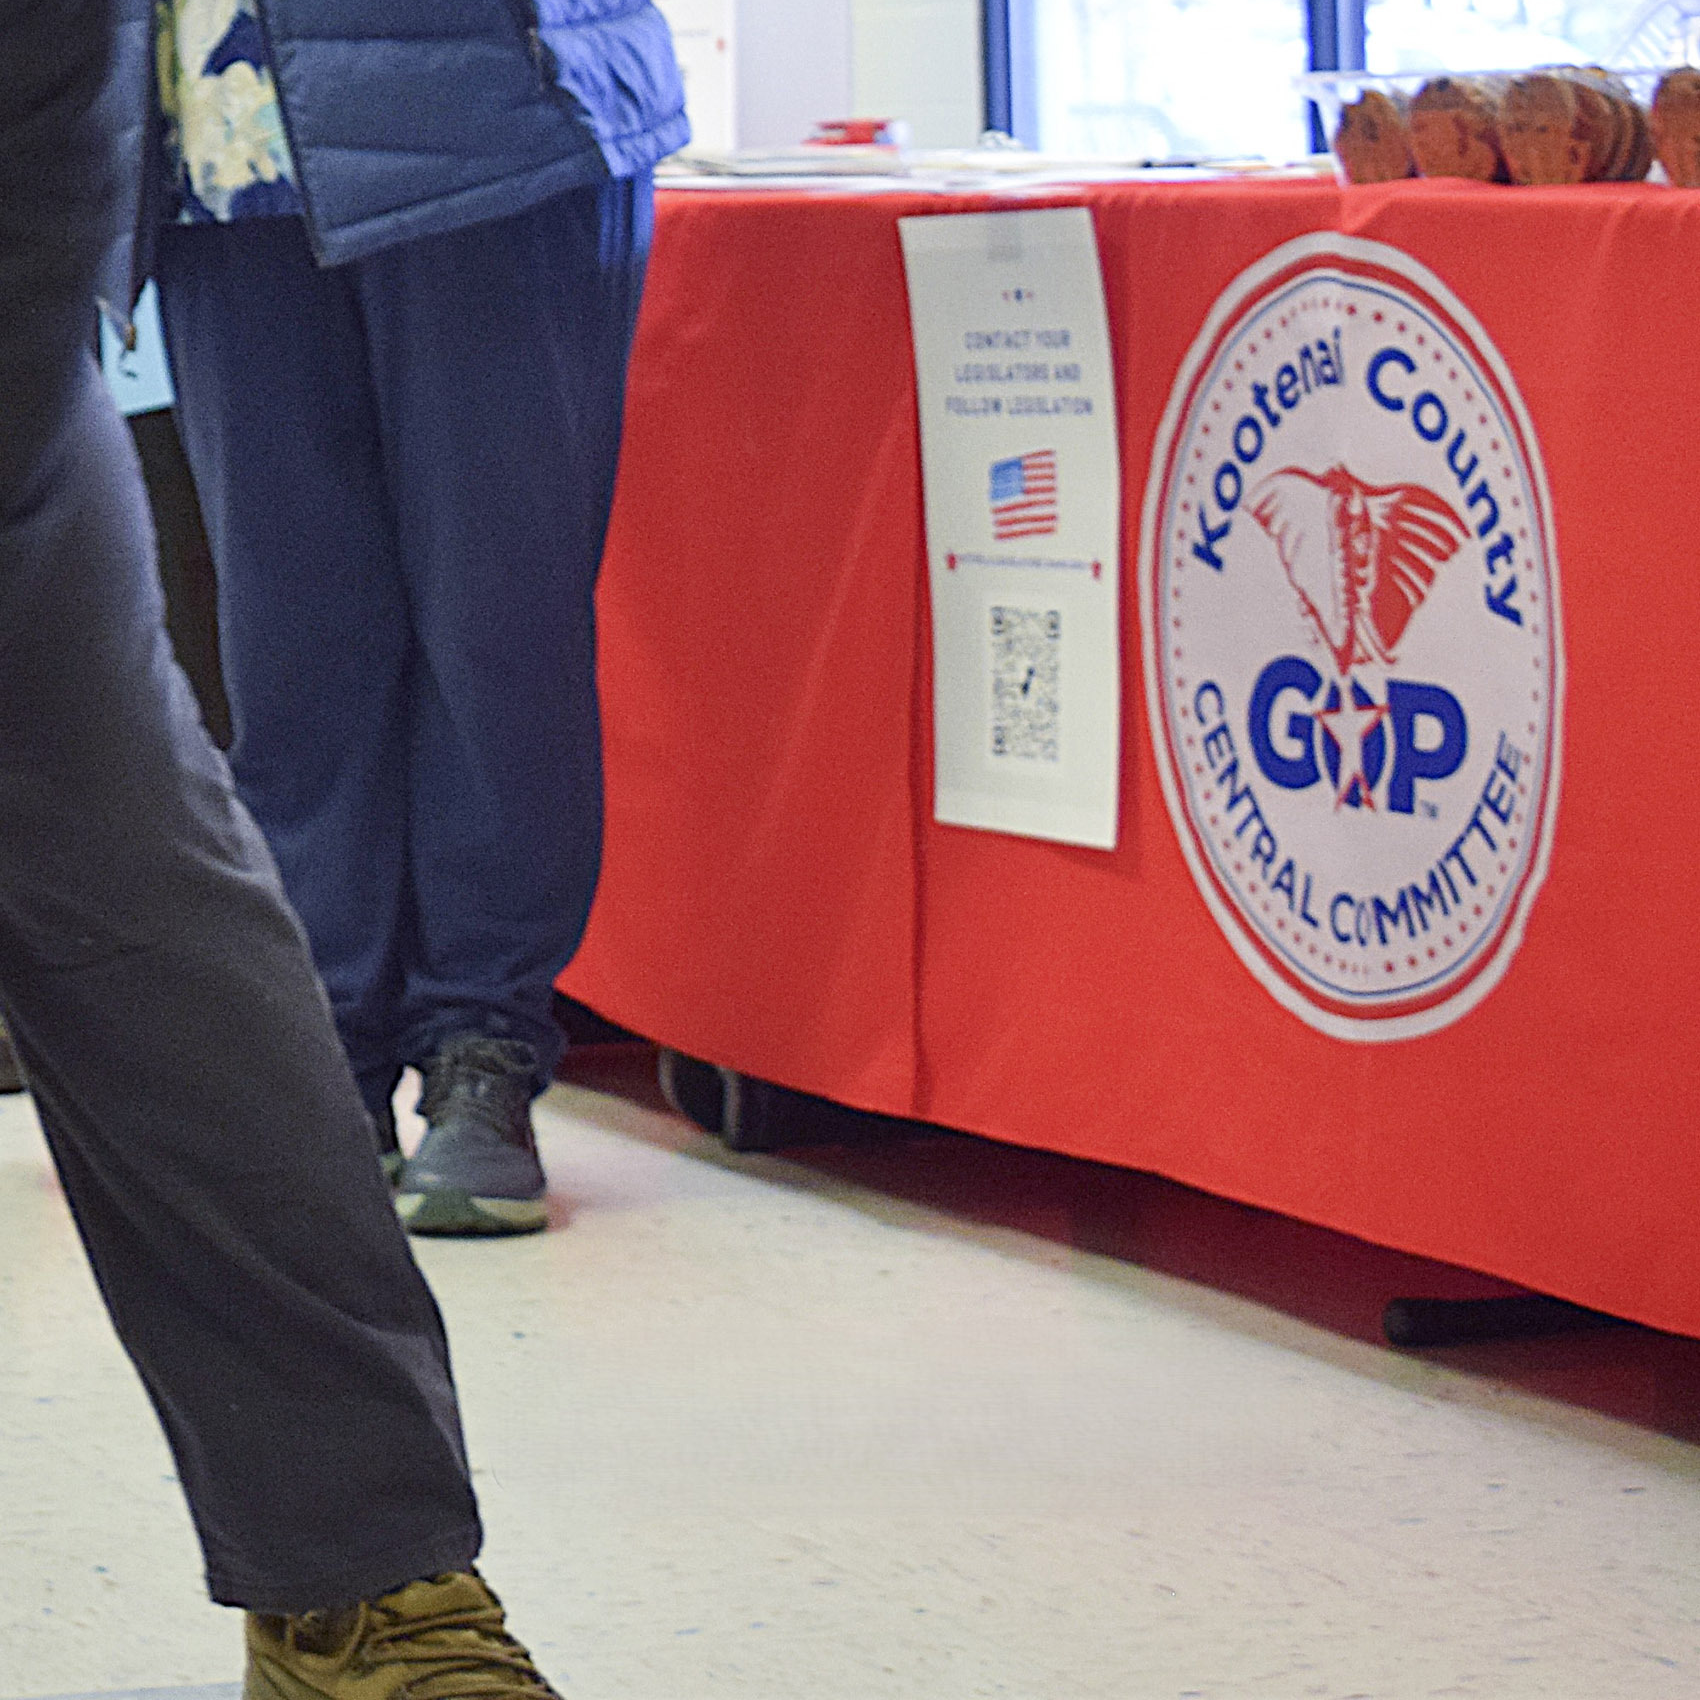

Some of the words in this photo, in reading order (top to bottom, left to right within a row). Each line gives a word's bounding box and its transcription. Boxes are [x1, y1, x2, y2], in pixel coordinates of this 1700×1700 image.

[1192, 325, 1346, 572] Kootenai
[1366, 347, 1524, 627] County
[1194, 679, 1319, 929] CENTRAL
[1330, 729, 1523, 947] COMMITTEE
[1248, 654, 1468, 815] GOP
